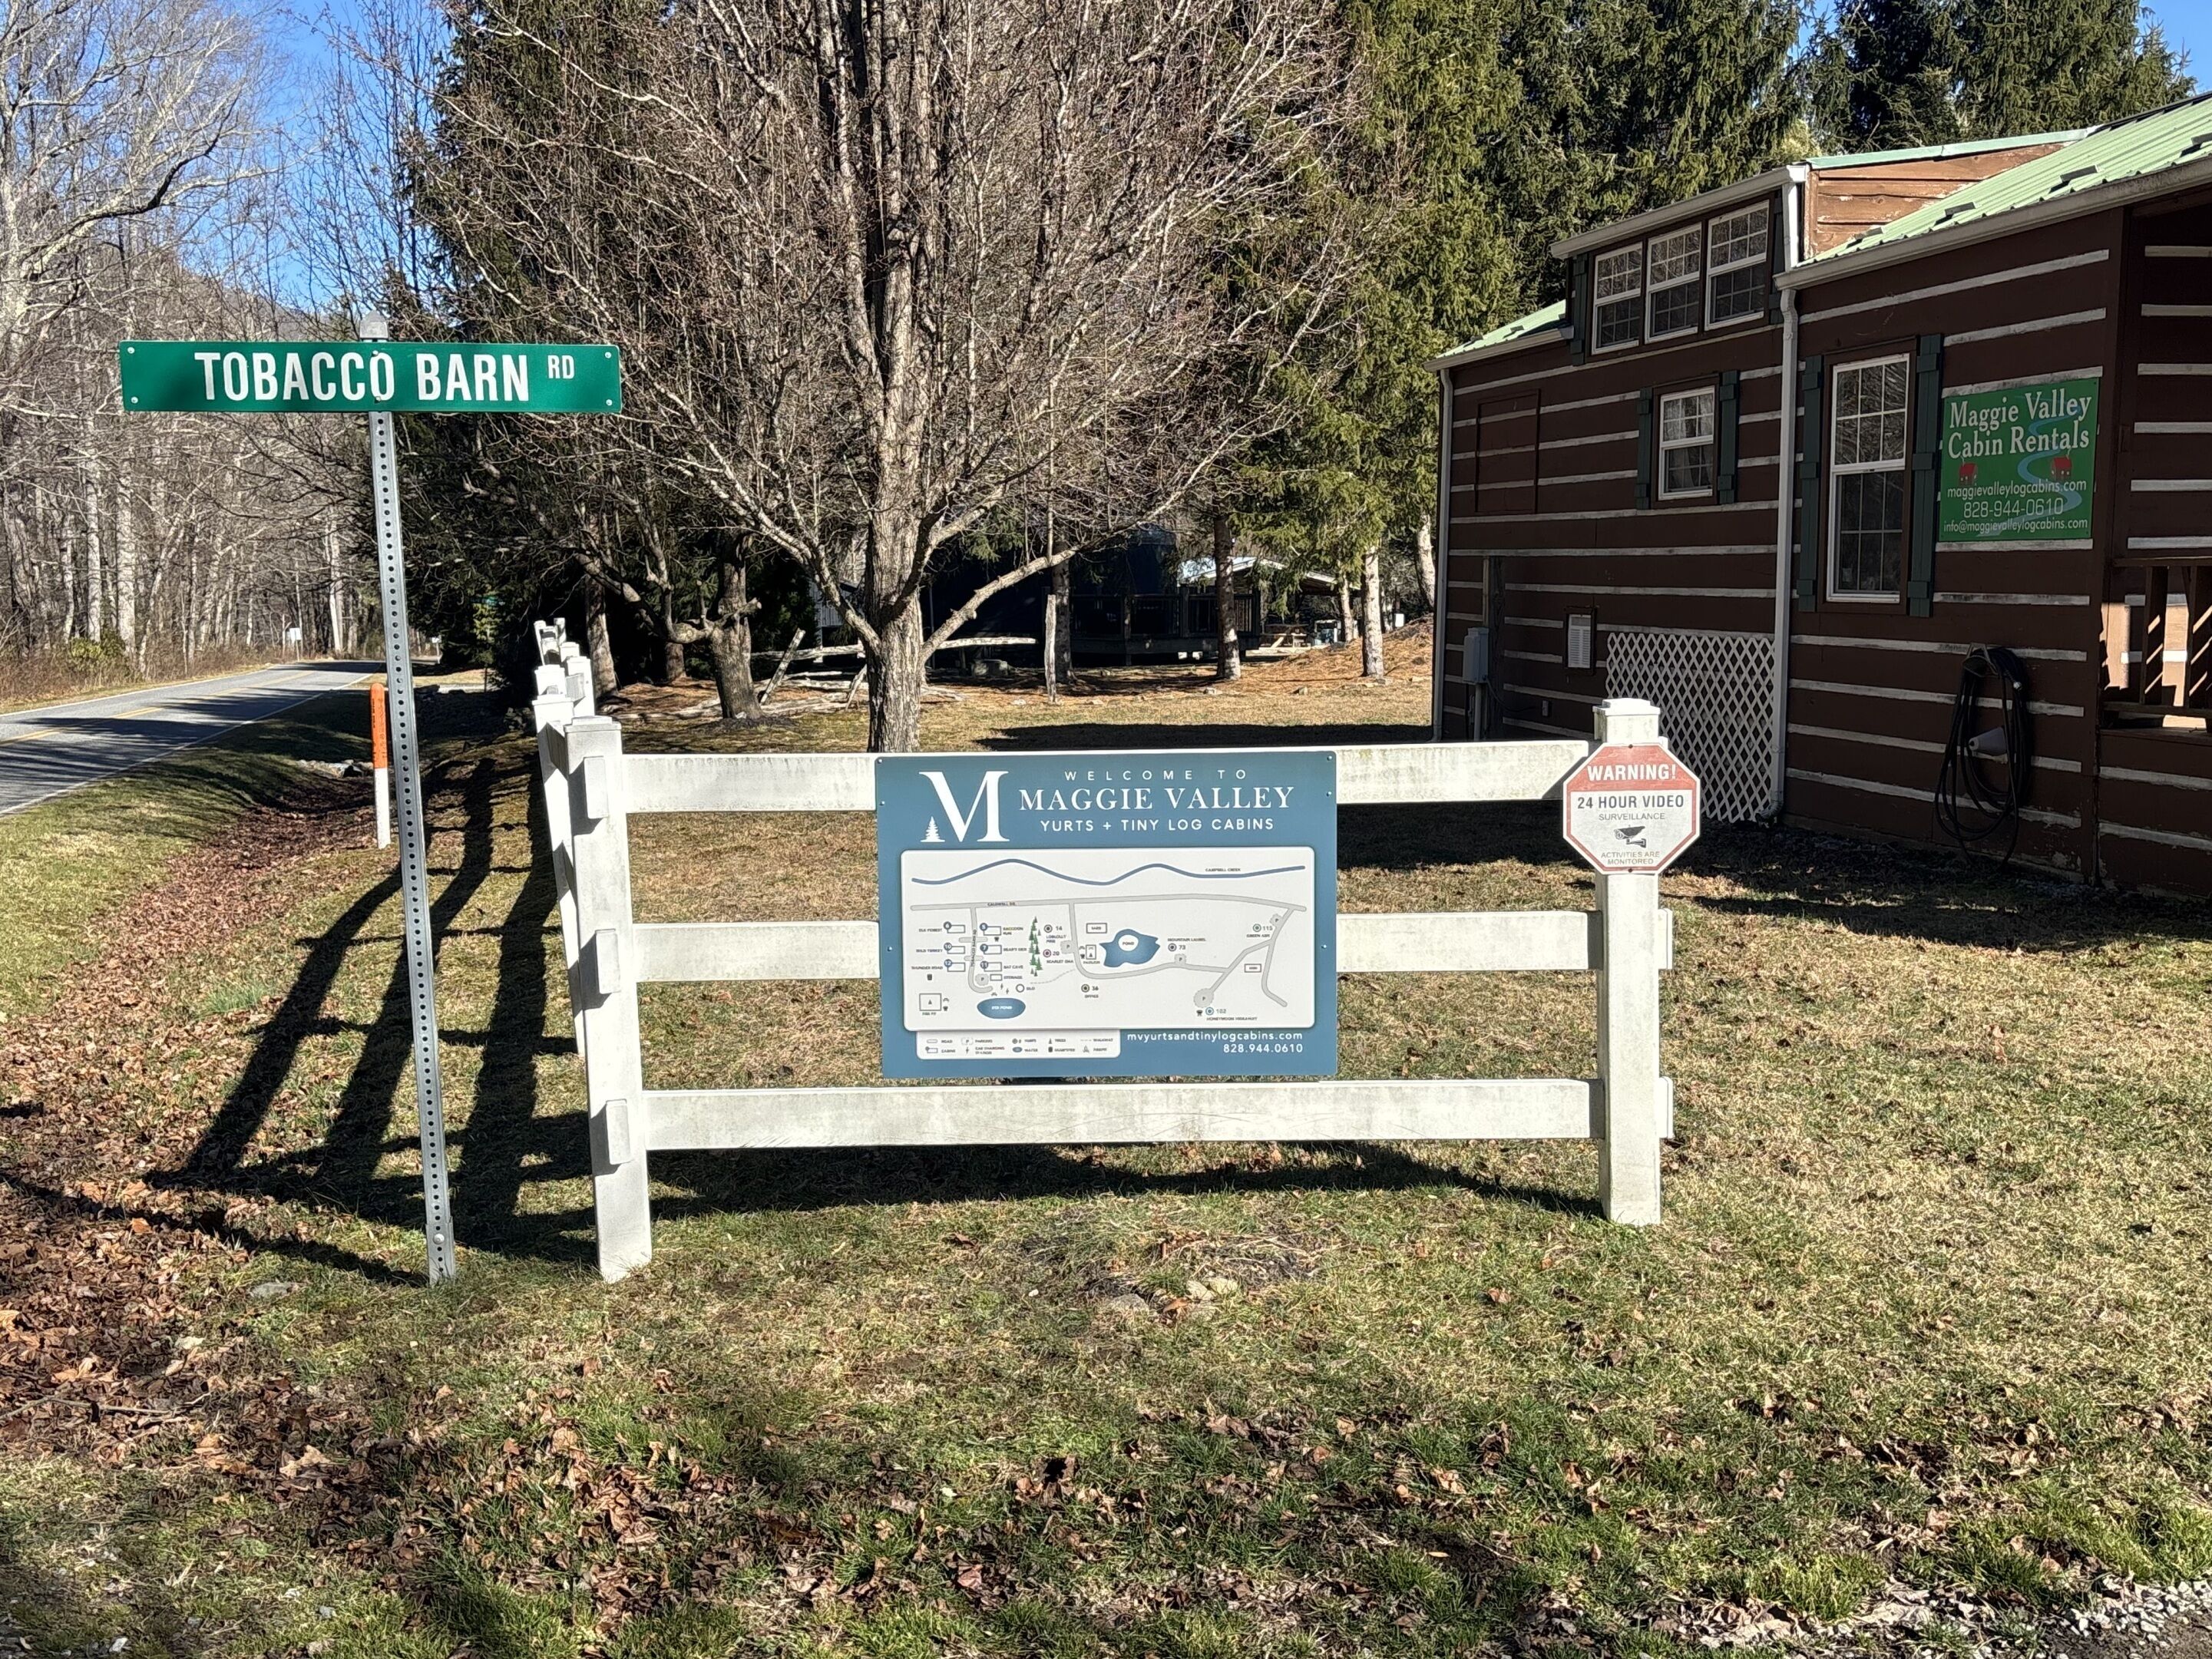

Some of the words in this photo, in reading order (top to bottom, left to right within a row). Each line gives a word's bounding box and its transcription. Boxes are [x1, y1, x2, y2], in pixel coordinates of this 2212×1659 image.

[194, 352, 395, 401] TOBACCO
[416, 353, 529, 401] BARN
[547, 355, 574, 379] RD
[1949, 396, 2019, 431] Maggie
[2025, 388, 2092, 421] Valley
[1948, 430, 2003, 459] Cabin
[2009, 420, 2089, 454] Rentals
[1947, 479, 2087, 500] maggievalleylogcabins.com
[1963, 497, 2064, 518] 828-944-0610
[1943, 518, 2088, 534] info@maggievalleylogcabins.com
[1064, 770, 1192, 781] WELCOME
[1218, 769, 1246, 780] TO
[1586, 764, 1677, 782] WARNING!
[1018, 787, 1152, 811] MAGGIE
[1164, 786, 1294, 809] VALLEY
[1577, 797, 1593, 809] 24
[1599, 796, 1637, 808] HOUR
[1642, 795, 1684, 808] VIDEO
[1040, 819, 1094, 831] YURTS
[1121, 819, 1159, 831] TINY
[1169, 818, 1202, 831] LOG
[1212, 818, 1274, 831] CABINS
[1599, 812, 1665, 821] SURVEILLANCE
[1127, 1030, 1303, 1043] mvyurtsandtinylogcabins.com
[1223, 1043, 1303, 1053] 828.944.0610
